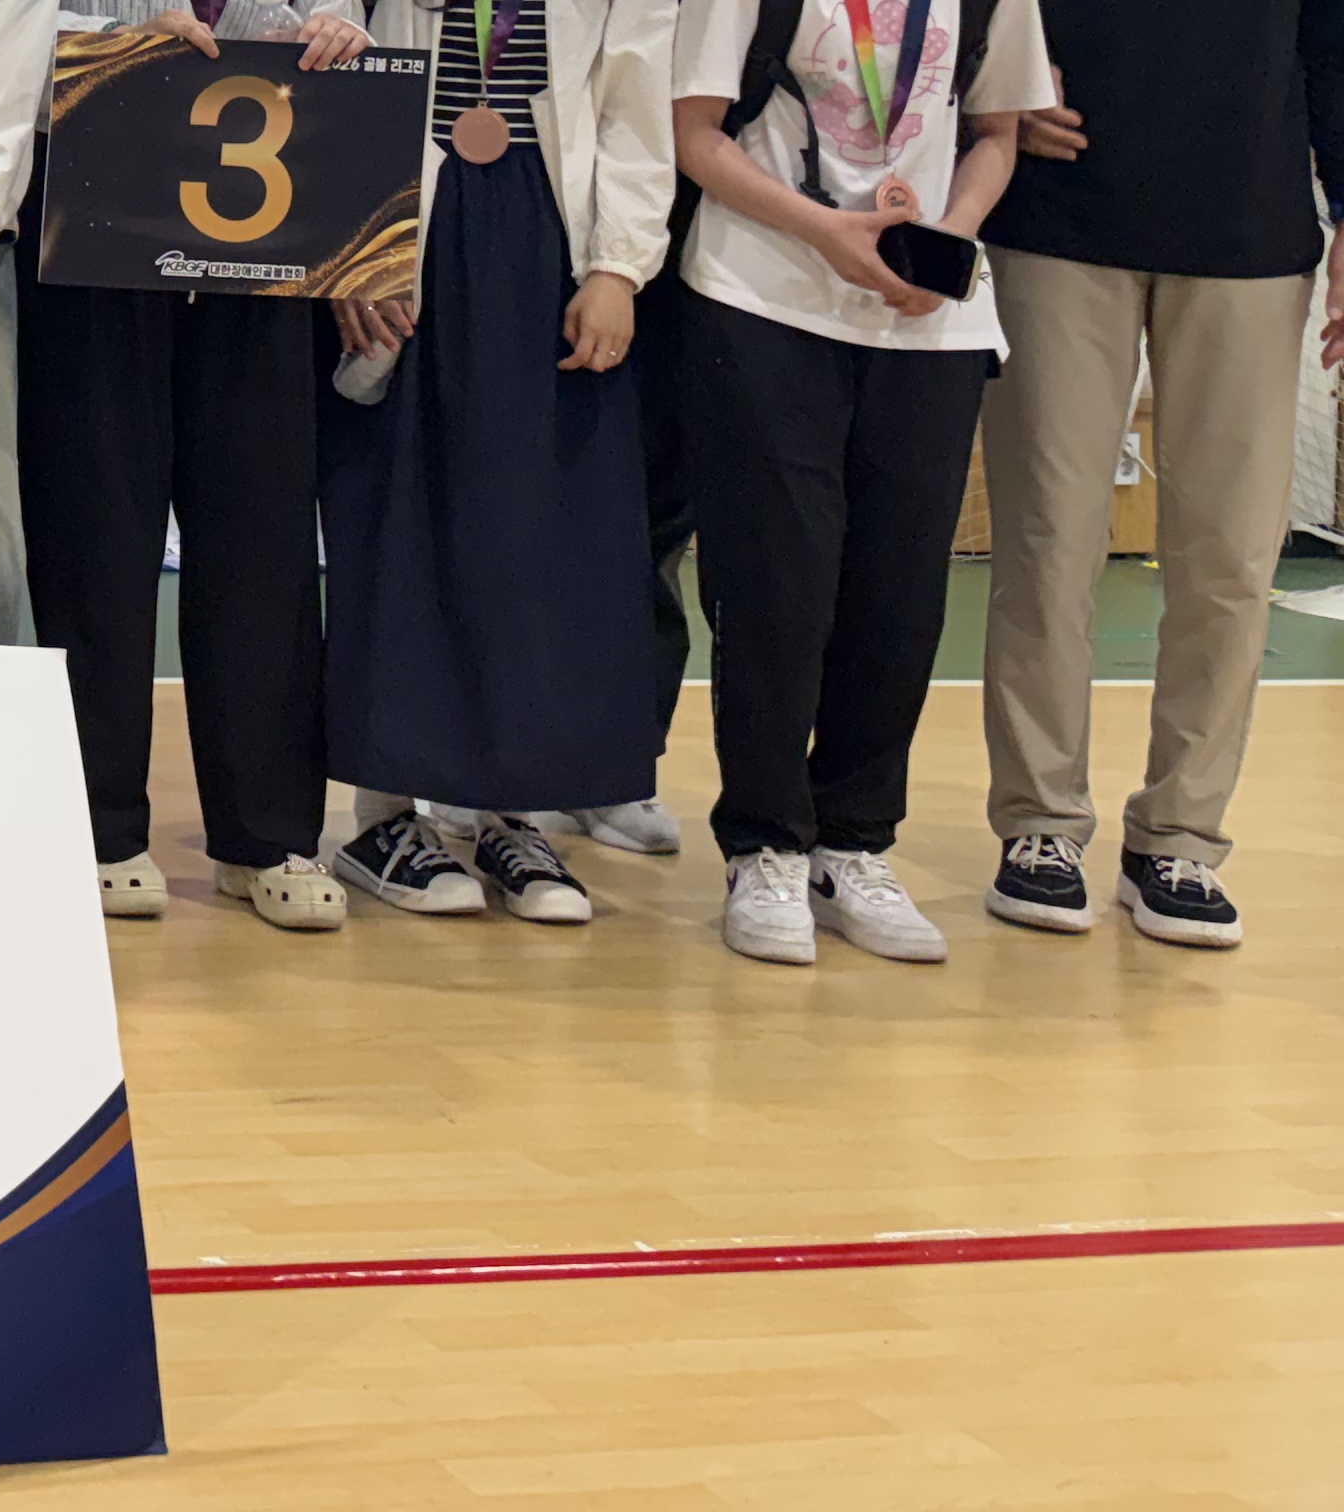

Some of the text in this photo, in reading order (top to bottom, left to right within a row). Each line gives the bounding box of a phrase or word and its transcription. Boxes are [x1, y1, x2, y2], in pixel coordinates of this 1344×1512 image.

[363, 56, 388, 73] 골볼
[390, 58, 425, 75] 리그전
[178, 75, 294, 243] 3
[163, 259, 208, 273] KBGF
